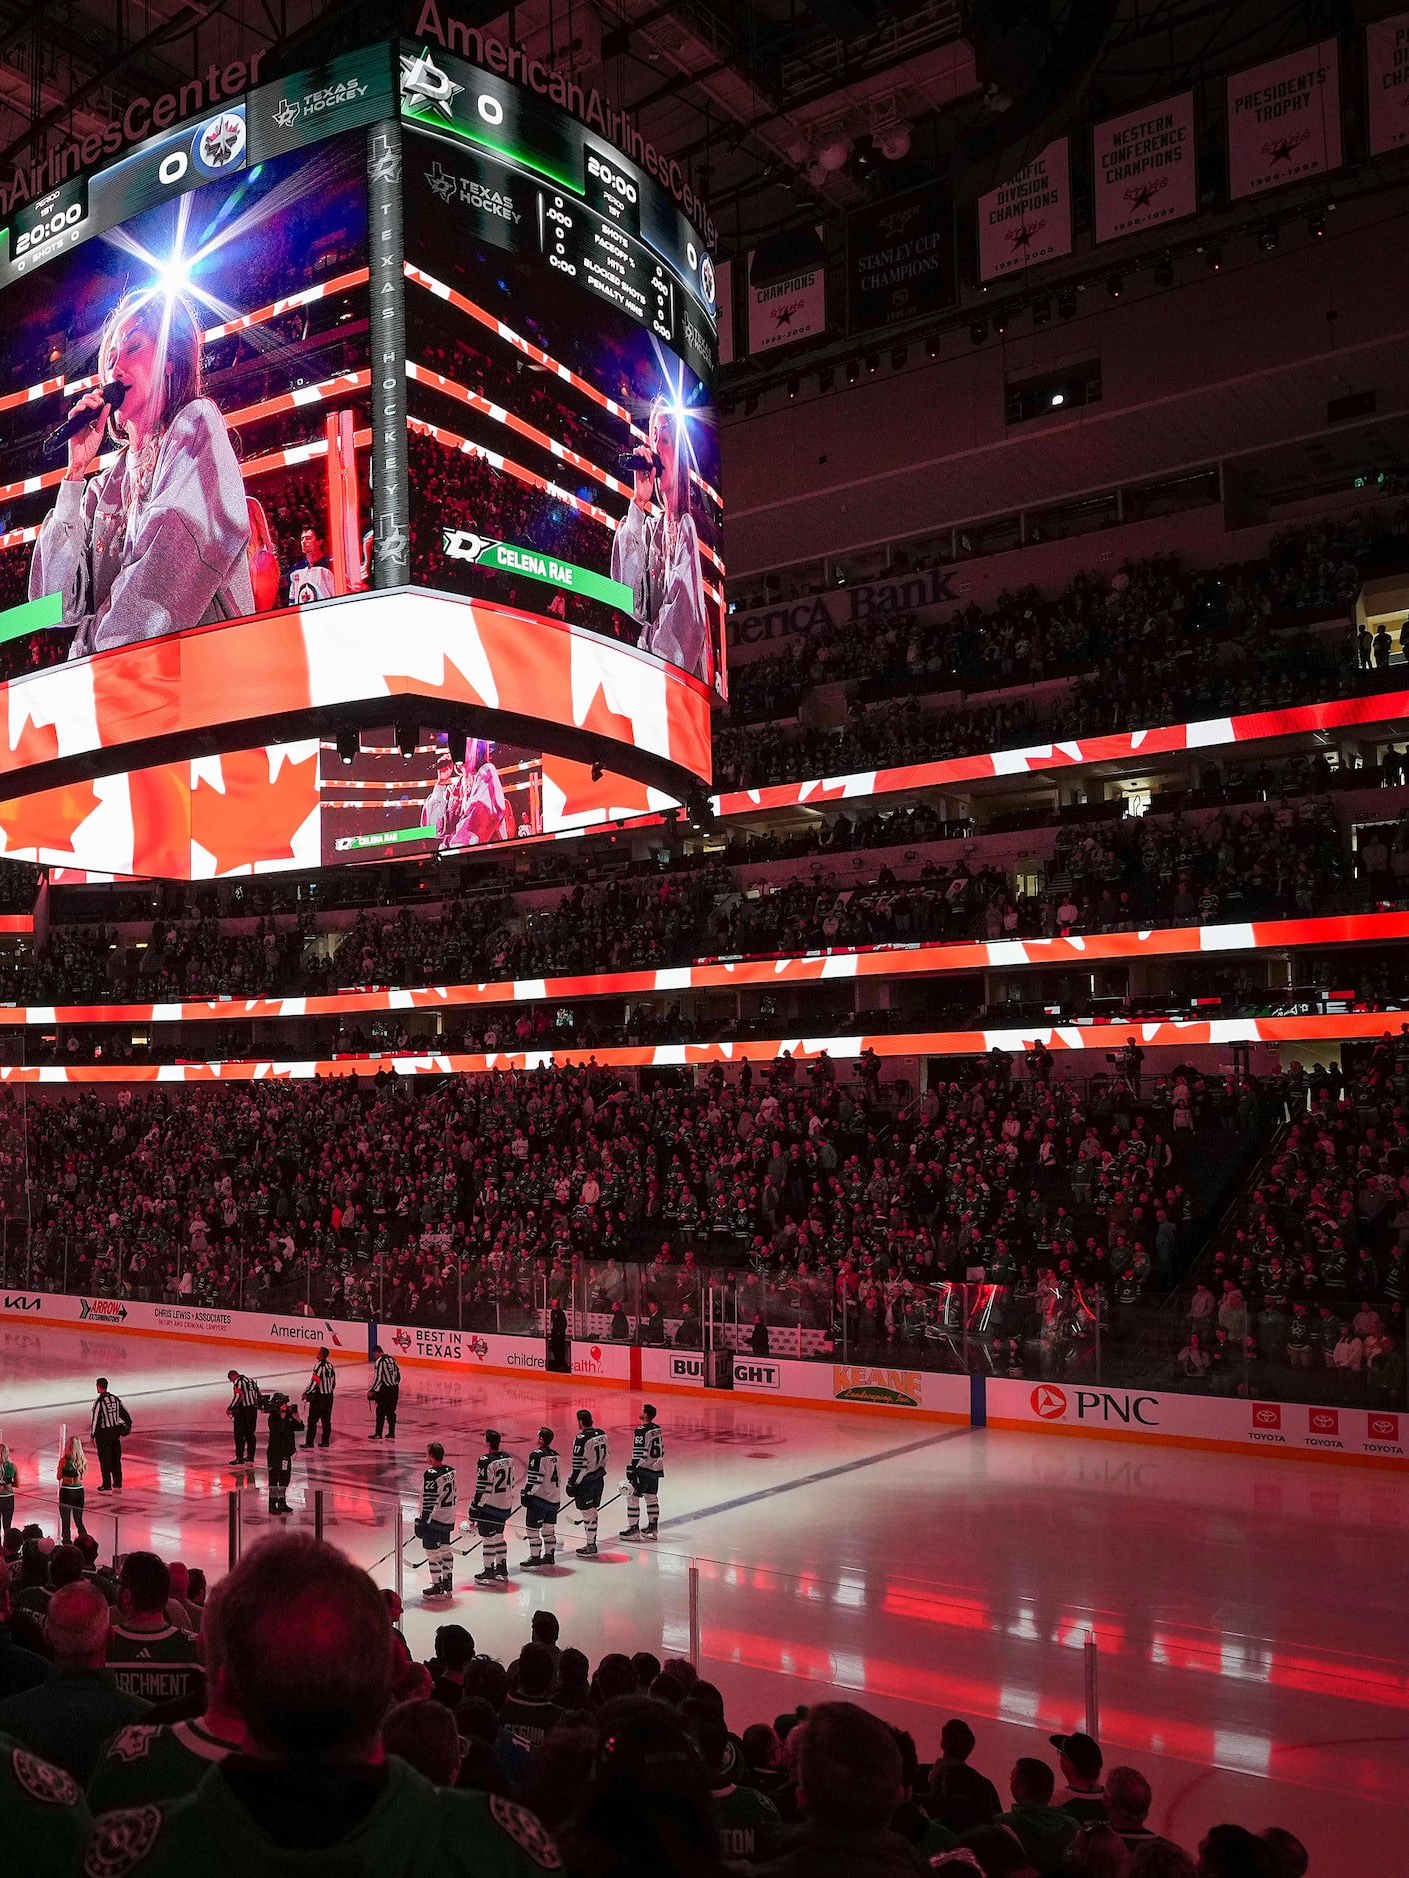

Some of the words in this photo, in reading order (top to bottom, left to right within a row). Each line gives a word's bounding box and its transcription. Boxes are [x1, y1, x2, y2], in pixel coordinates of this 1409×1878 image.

[303, 78, 358, 105] TEXAS
[304, 85, 368, 116] HOCKEY
[1255, 91, 1311, 124] TROPHY
[477, 94, 503, 125] 0
[1113, 114, 1173, 147] WESTERN
[1102, 127, 1186, 168] CONFERENCE
[159, 152, 187, 184] 0
[587, 156, 637, 203] 20:00
[1106, 146, 1182, 184] CHAMPIONS
[459, 178, 514, 209] TEXAS
[989, 189, 1058, 225] CHAMPIONS
[997, 176, 1049, 206] DIVISION
[459, 191, 522, 225] HOCKEY
[554, 197, 563, 208] 0
[601, 224, 628, 248] SHOTS
[16, 203, 81, 255] 20:00
[32, 239, 64, 262] SHOTS
[71, 231, 80, 241] 0
[379, 203, 396, 320] TEXAS
[555, 228, 564, 239] 0
[607, 257, 626, 275] HITS
[594, 234, 628, 263] FACEOFF
[687, 242, 697, 270] 0
[858, 241, 914, 272] STANLEY
[915, 233, 940, 252] CUP
[549, 255, 576, 276] 0:00
[587, 276, 624, 305] PENALTY
[625, 298, 643, 317] MINS
[556, 243, 565, 255] 0
[584, 258, 621, 286] BLOCKED
[621, 281, 646, 305] SHOTS
[757, 272, 814, 304] CHAMPIONS
[861, 254, 939, 291] CHAMPIONS
[381, 351, 399, 496] HOCKEY
[497, 547, 547, 577] CELENA
[549, 563, 573, 585] RAE
[847, 570, 960, 623] Bank
[91, 1300, 121, 1315] ARROW
[155, 1308, 172, 1318] CHRIS
[173, 1310, 191, 1320] LEWIS
[195, 1313, 231, 1324] ASSOCIATES
[271, 1323, 324, 1341] American
[416, 1330, 445, 1342] BEST
[450, 1333, 461, 1344] IN
[416, 1343, 461, 1359] TEXAS
[833, 1366, 922, 1403] KEANE
[1073, 1391, 1160, 1425] PNC
[1248, 1432, 1286, 1443] TOYOTA
[1305, 1438, 1343, 1448] TOYOTA
[1362, 1443, 1403, 1455] TOYOTA
[551, 1464, 559, 1488] 4
